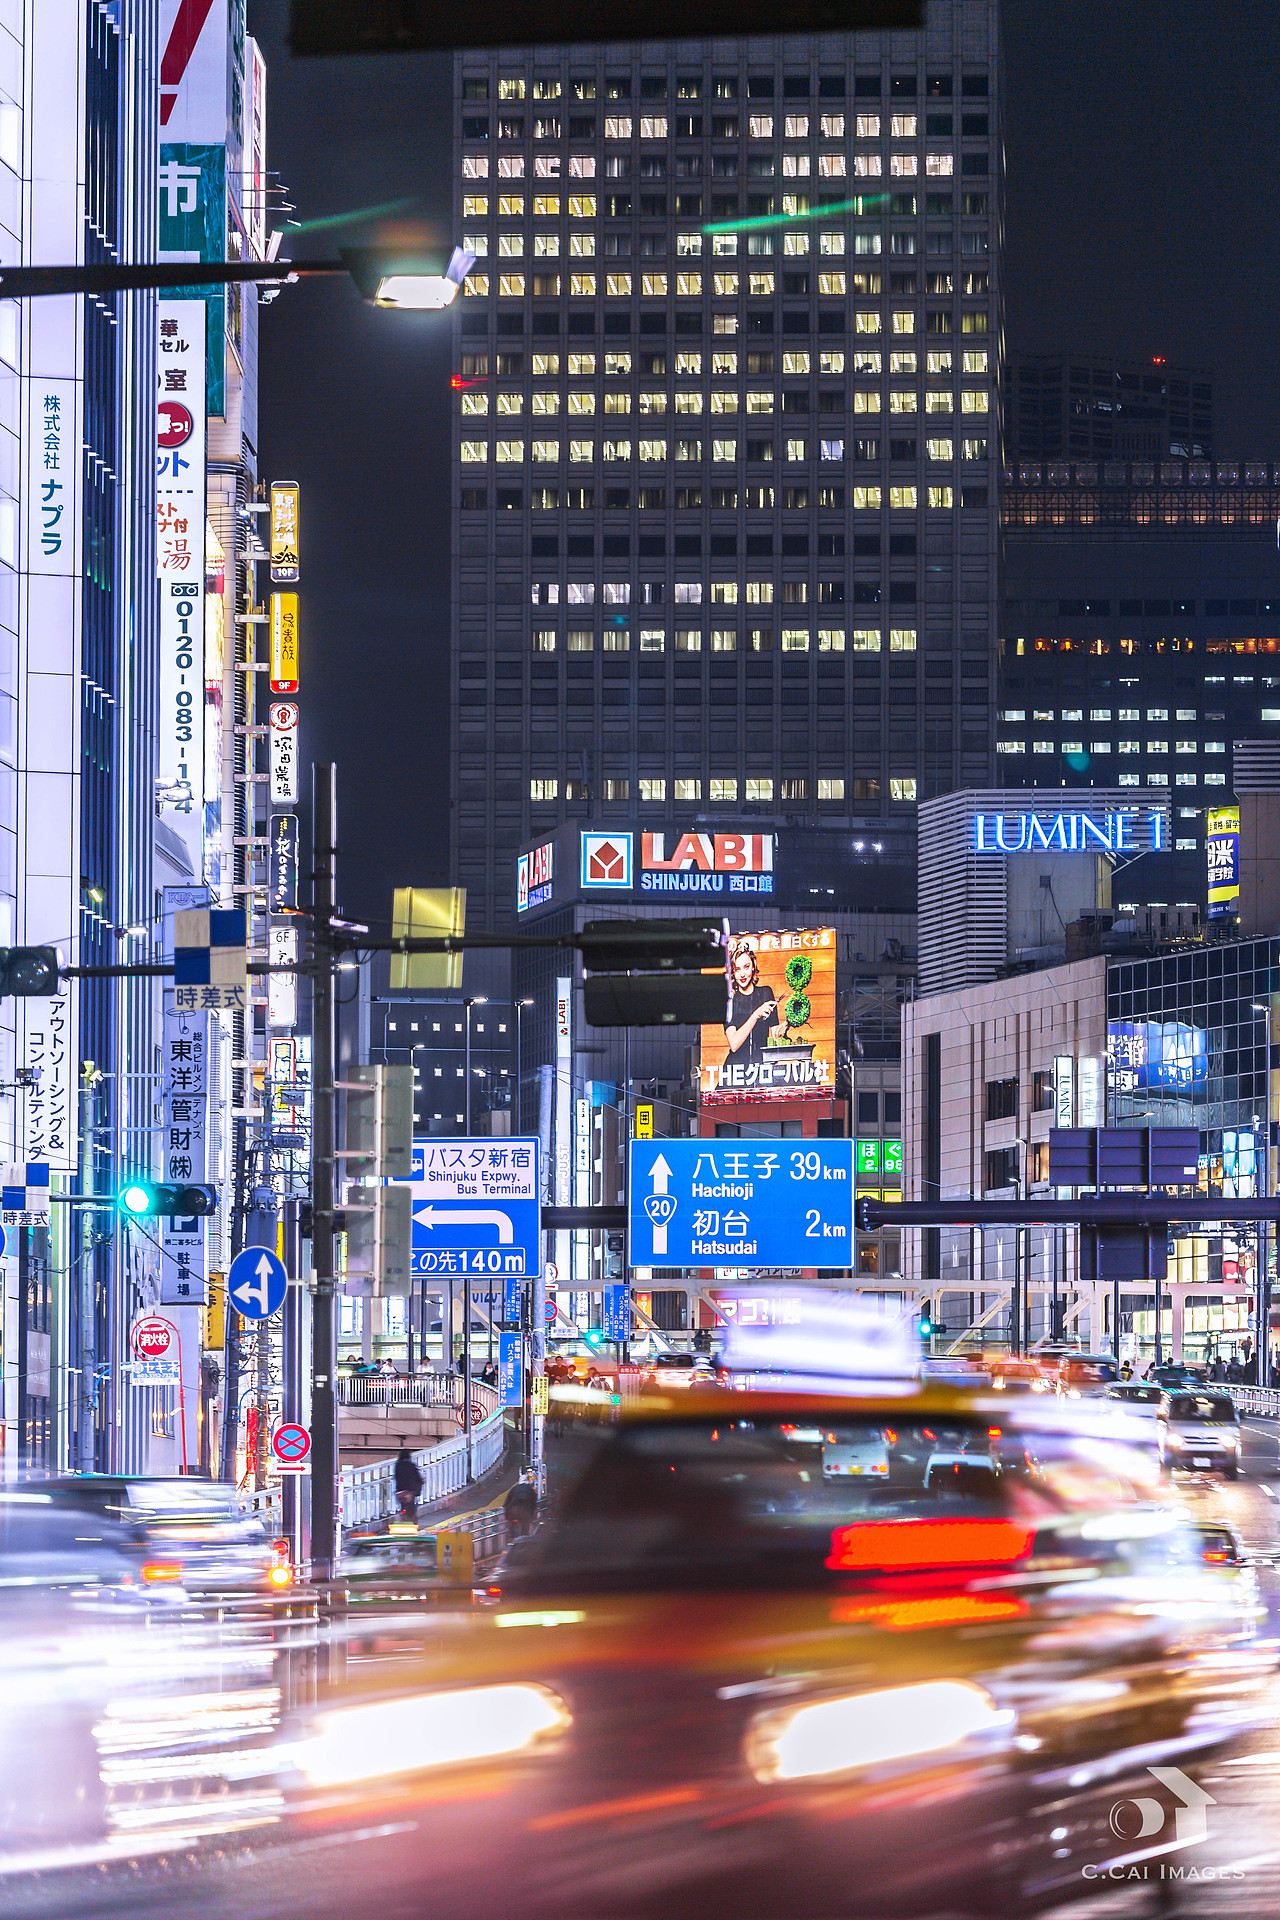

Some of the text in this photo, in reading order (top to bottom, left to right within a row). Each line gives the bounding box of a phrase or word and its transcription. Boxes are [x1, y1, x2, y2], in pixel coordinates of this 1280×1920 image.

[157, 368, 187, 392] 室
[278, 681, 291, 690] 9F
[976, 813, 1162, 851] LUMINE 1
[641, 832, 774, 872] LABI
[640, 872, 774, 893] SHINJUKU 西口館
[276, 931, 290, 943] 6F
[176, 986, 245, 1010] 時差式
[28, 1032, 46, 1162] コンルティング
[428, 1148, 531, 1168] バスタ新宿
[692, 1153, 780, 1179] 八王子
[428, 1171, 521, 1183] Shinjuku Expwy.
[457, 1184, 531, 1194] Bus Terminal
[692, 1183, 754, 1200] Hachioji
[3, 1211, 48, 1226] 時差式
[651, 1200, 670, 1217] 20
[692, 1209, 751, 1237] 初台
[692, 1240, 758, 1255] Hatsudai
[177, 1251, 190, 1296] 駐車場
[140, 1332, 168, 1346] 消火栓
